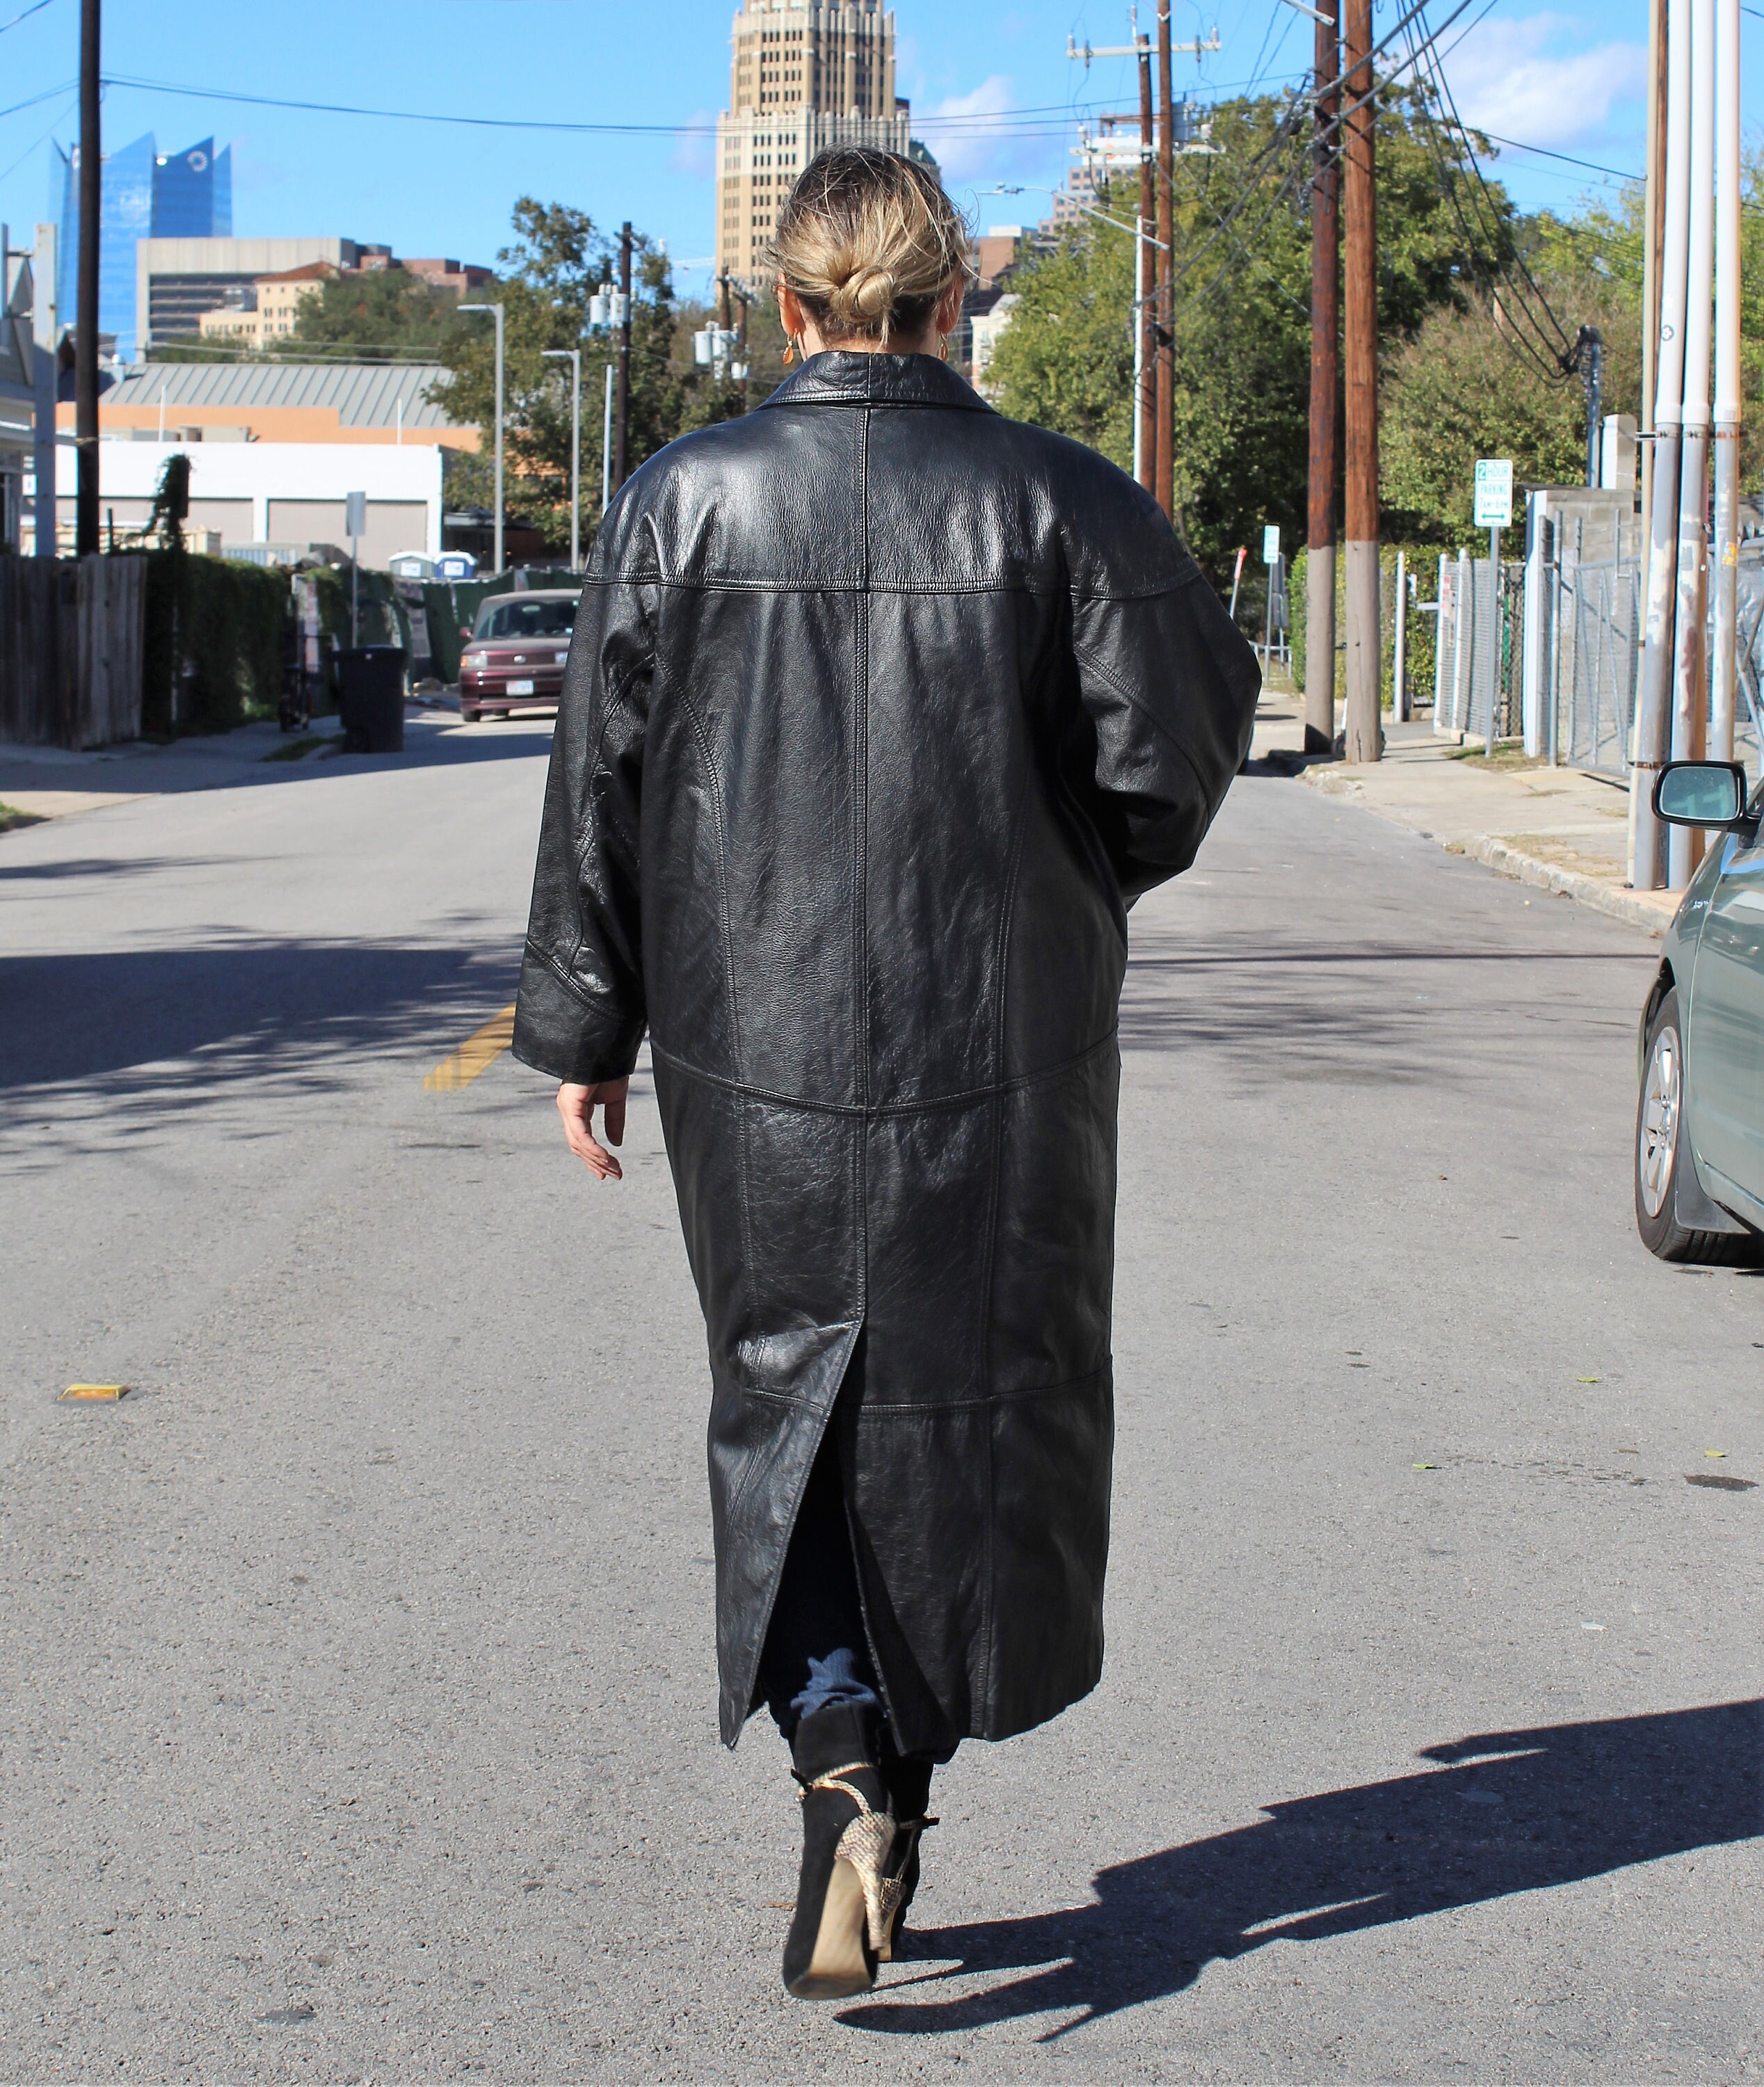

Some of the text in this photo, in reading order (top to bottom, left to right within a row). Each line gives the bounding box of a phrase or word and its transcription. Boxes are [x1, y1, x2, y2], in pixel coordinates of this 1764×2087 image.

[1479, 464, 1508, 479] 2 HOUR
[1480, 484, 1507, 495] PARKING
